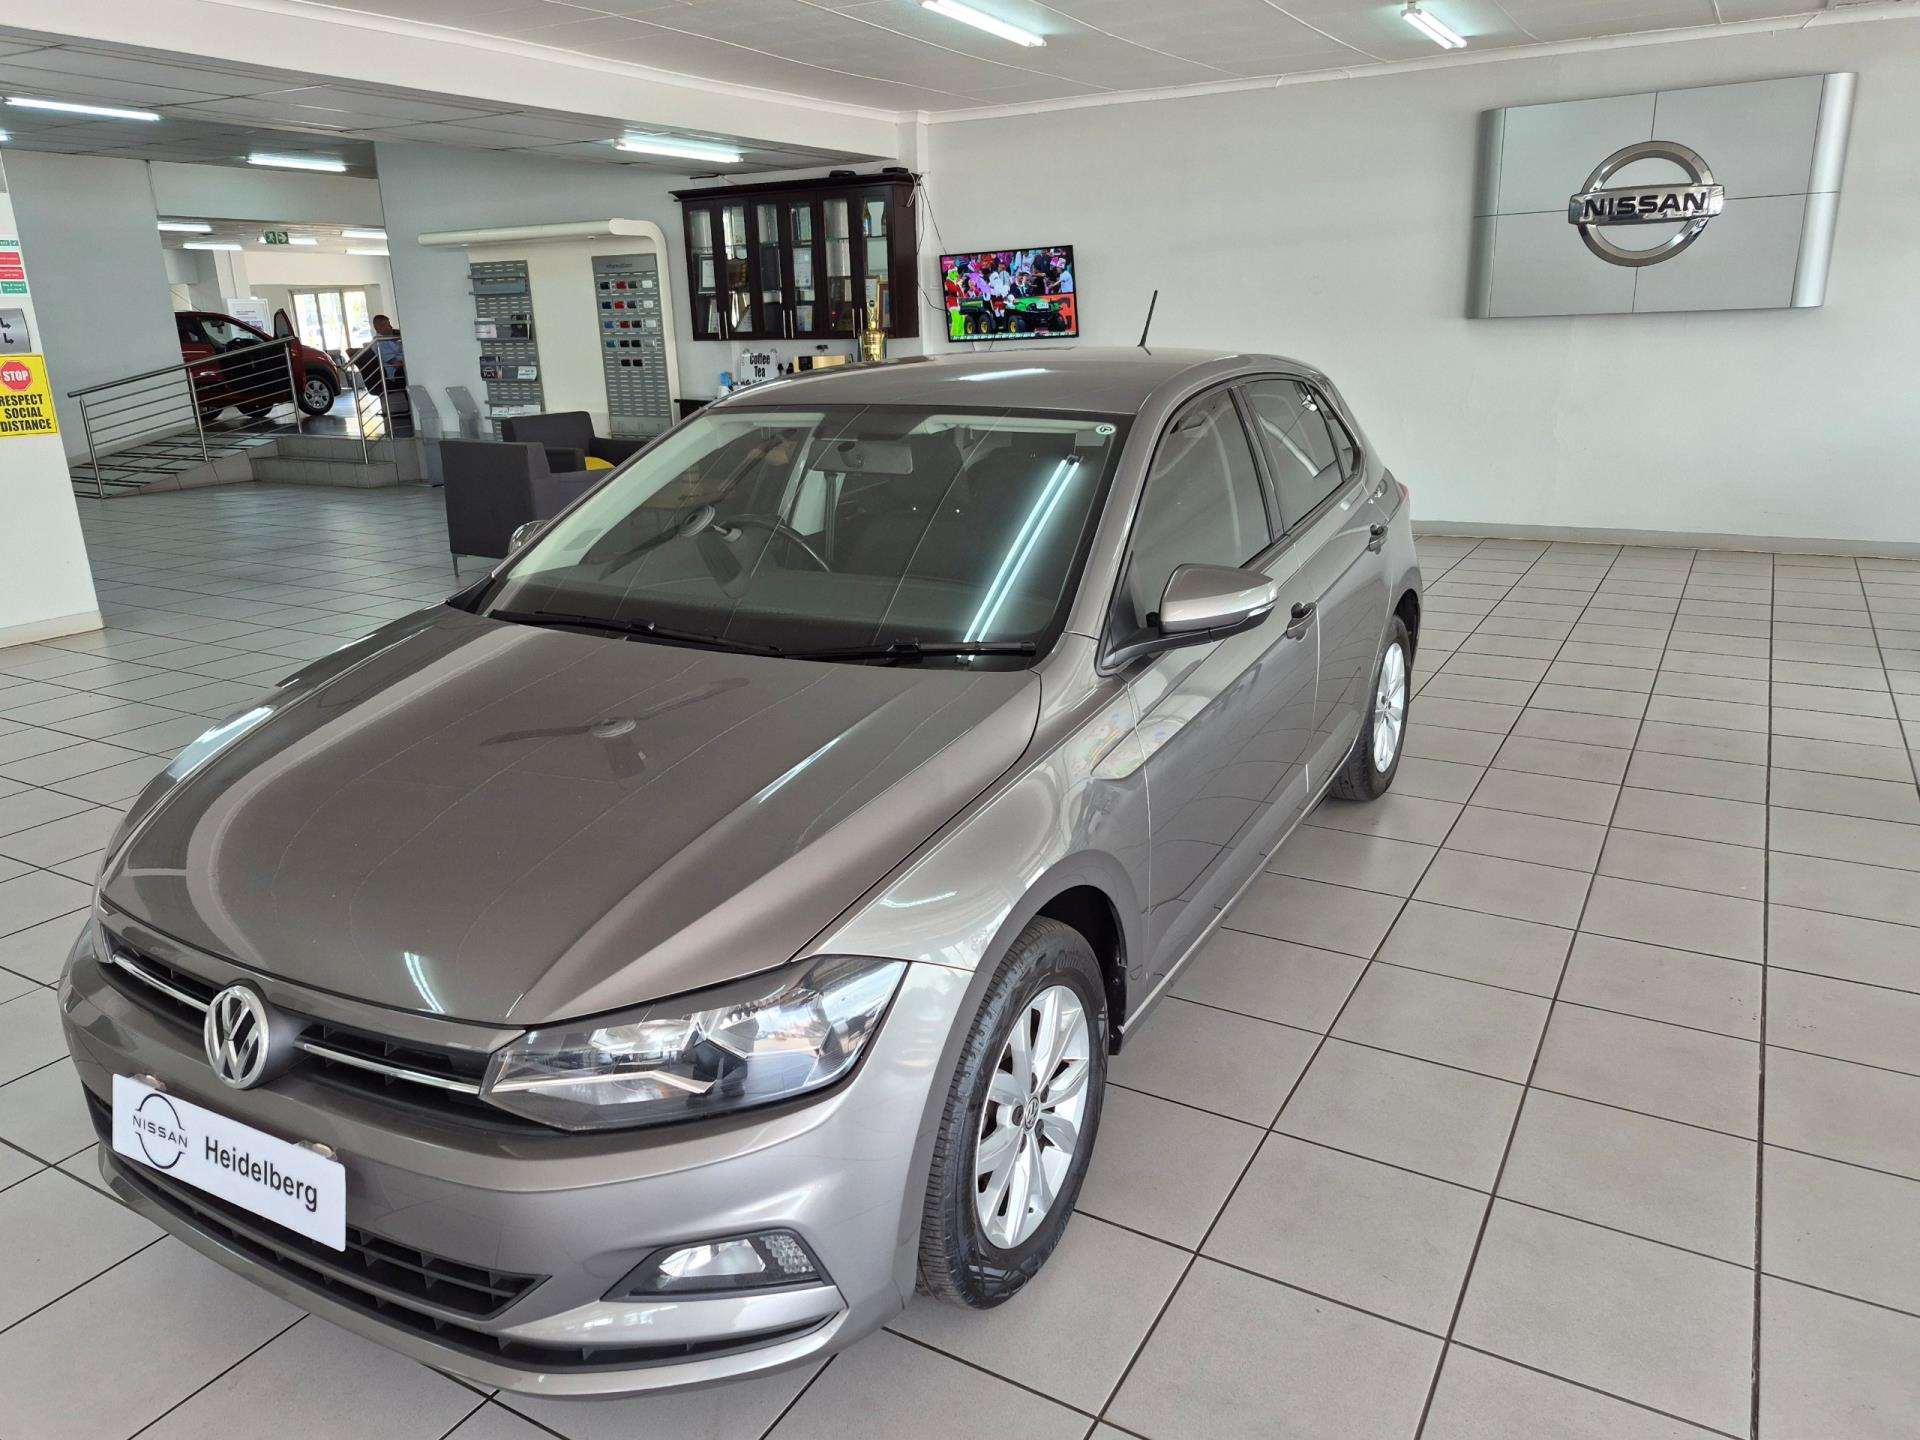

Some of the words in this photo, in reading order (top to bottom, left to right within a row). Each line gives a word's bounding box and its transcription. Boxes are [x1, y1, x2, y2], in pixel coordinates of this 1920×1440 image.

[1584, 192, 1707, 217] NISSAN
[750, 352, 770, 365] Coffee
[2, 370, 29, 382] STOP
[754, 365, 766, 378] Tea
[0, 393, 43, 407] RESPECT
[4, 407, 43, 419] SOCIAL
[0, 418, 52, 432] DISTANCE
[132, 1115, 188, 1148] NISSAN
[205, 1136, 318, 1213] Heidelberg
